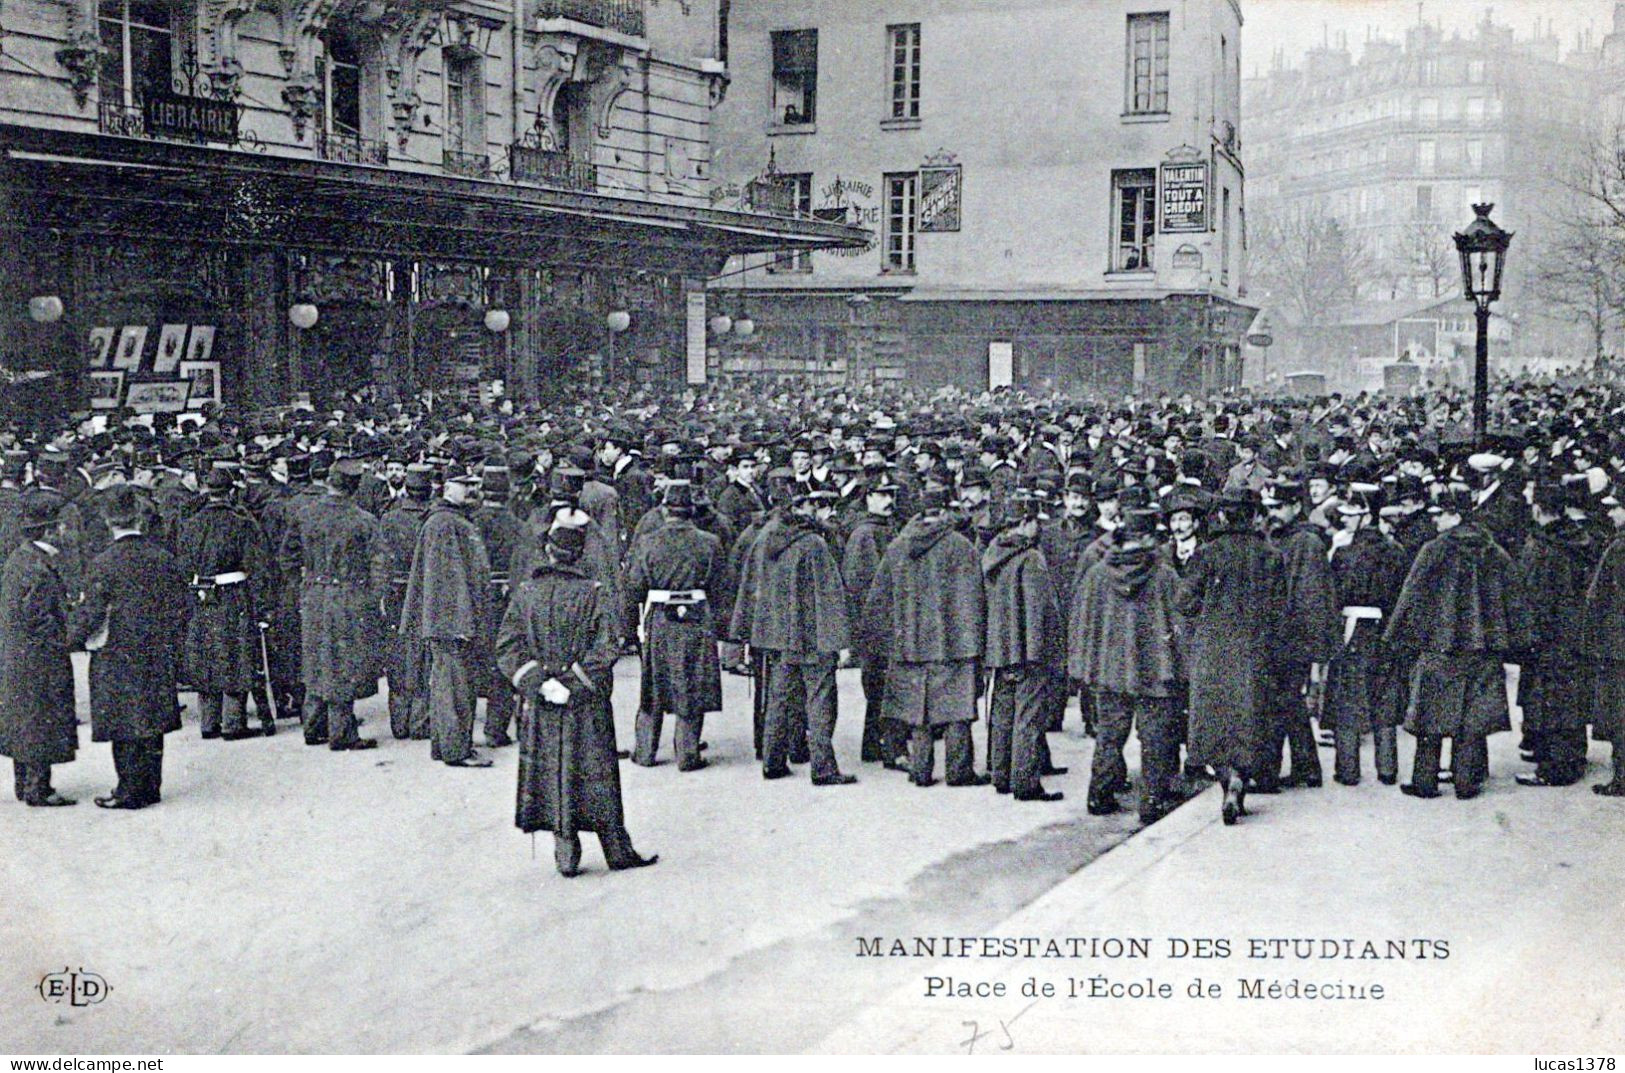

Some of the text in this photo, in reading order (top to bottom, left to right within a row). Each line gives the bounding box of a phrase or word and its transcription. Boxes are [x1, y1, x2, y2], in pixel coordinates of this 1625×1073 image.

[151, 101, 233, 134] LIBRAIRIE
[1164, 167, 1204, 182] VALENTIN
[821, 180, 874, 199] LIBRAIRIE
[1165, 189, 1193, 202] TOUT
[1164, 201, 1204, 214] CREDIT
